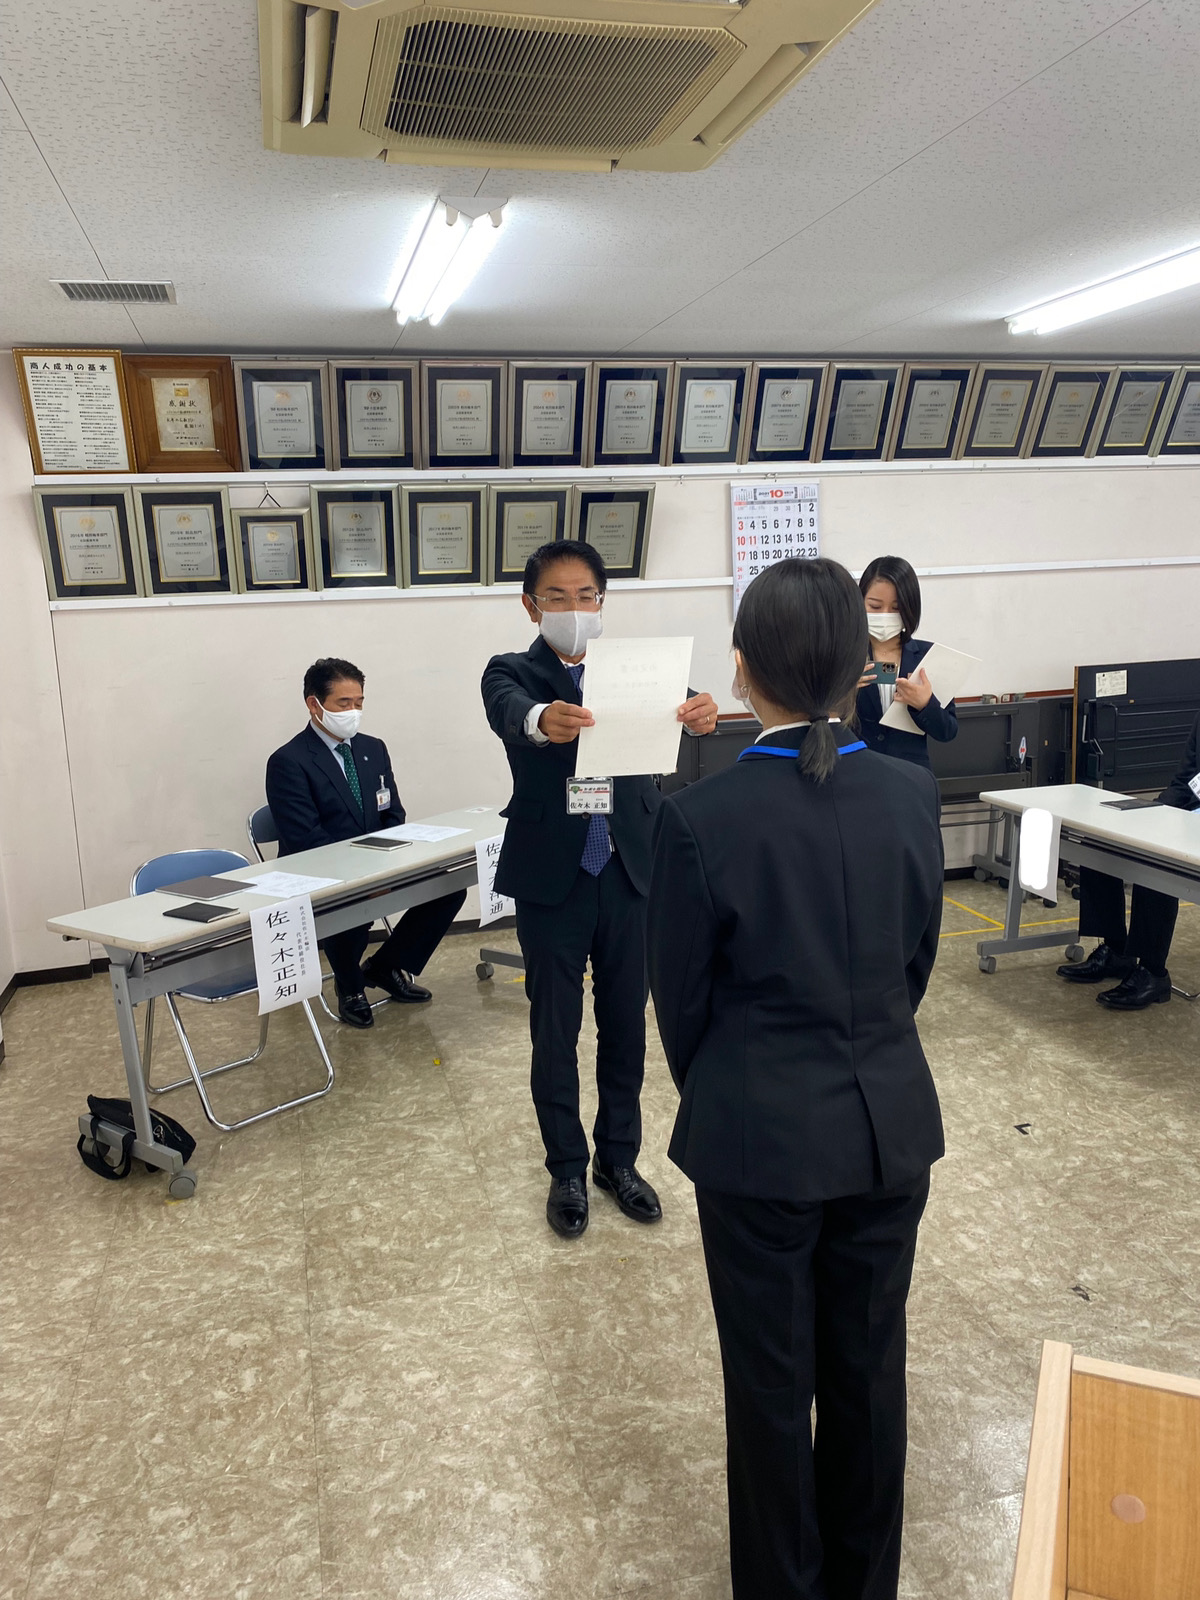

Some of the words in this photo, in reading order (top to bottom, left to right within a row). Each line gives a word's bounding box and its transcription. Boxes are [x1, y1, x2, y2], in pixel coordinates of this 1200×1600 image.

[30, 362, 108, 372] 商人成功の基本
[770, 490, 784, 498] 10
[797, 503, 802, 512] 1
[809, 503, 814, 512] 2
[738, 521, 744, 530] 3
[750, 520, 756, 530] 4
[762, 520, 767, 529] 5
[773, 519, 779, 529] 6
[785, 519, 791, 528] 7
[797, 518, 803, 528] 8
[809, 518, 815, 527] 9
[737, 536, 746, 546] 10
[749, 536, 757, 545] 11
[761, 535, 769, 545] 12
[772, 534, 781, 544] 13
[785, 534, 793, 543] 14
[796, 533, 805, 542] 15
[808, 533, 817, 542] 16
[737, 551, 746, 561] 17
[749, 551, 758, 560] 18
[761, 550, 770, 560] 19
[772, 549, 782, 559] 20
[784, 549, 793, 558] 21
[796, 548, 806, 557] 22
[808, 547, 817, 557] 23
[749, 566, 759, 575] 25
[486, 843, 503, 915] 佐々通
[266, 910, 297, 1002] 佐々木正知
